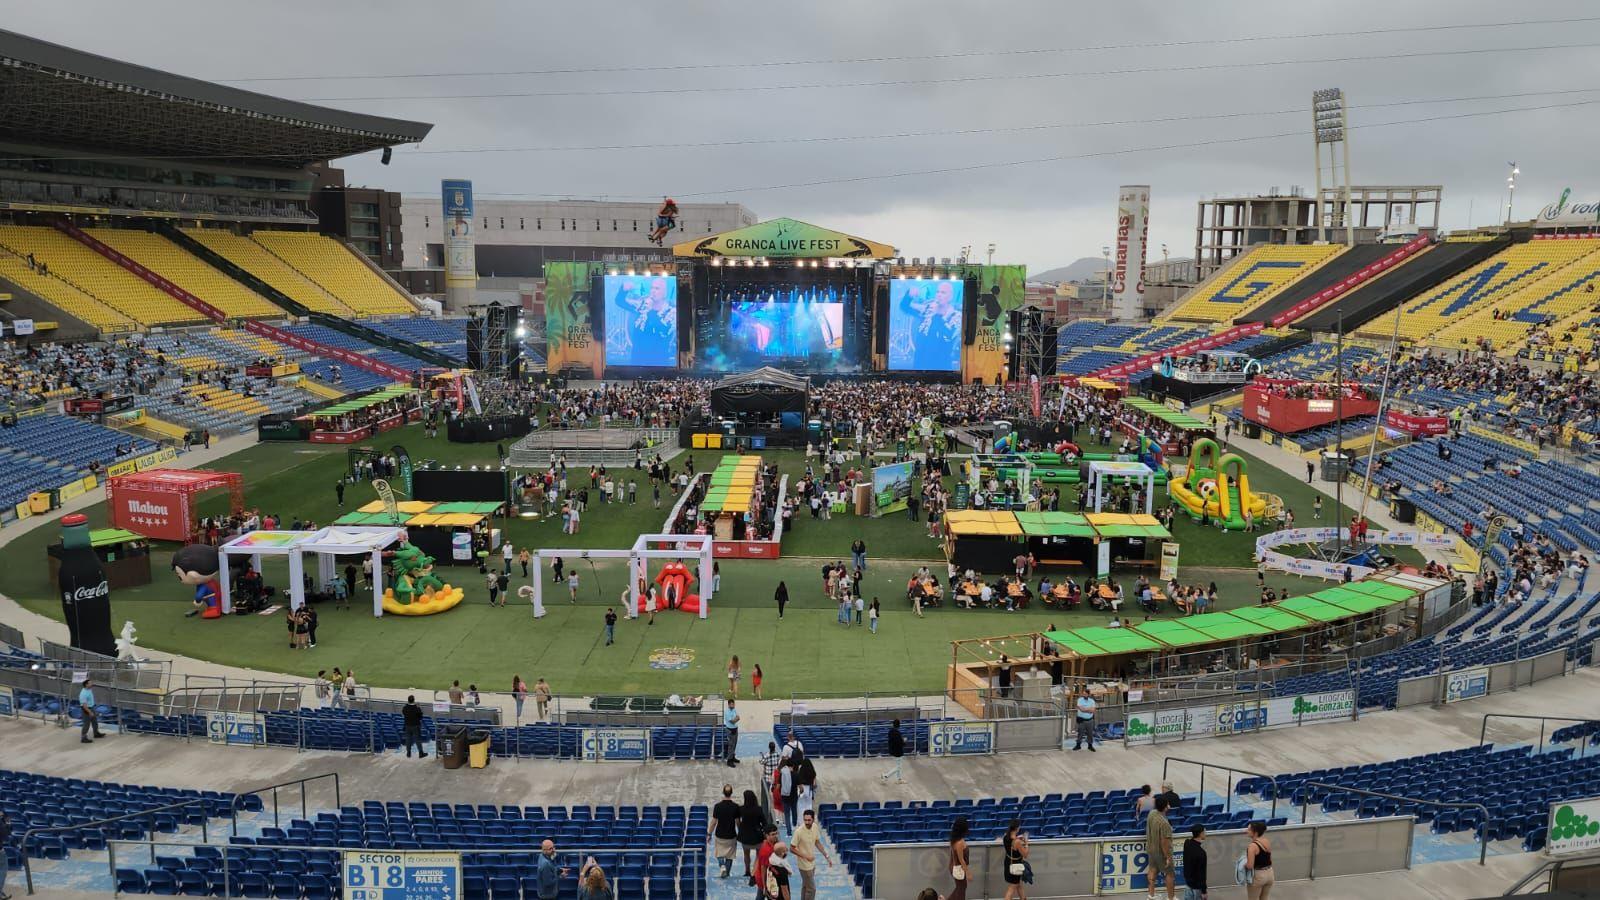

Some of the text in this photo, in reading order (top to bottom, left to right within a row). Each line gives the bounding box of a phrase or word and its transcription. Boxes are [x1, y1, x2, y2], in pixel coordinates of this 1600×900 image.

[726, 238, 841, 250] GRANCA LIVE FEST
[568, 340, 591, 349] FEST
[127, 500, 169, 516] Mahou
[1450, 680, 1468, 692] C21
[1219, 711, 1244, 724] C20
[209, 721, 236, 734] C17
[585, 738, 617, 751] C18
[933, 732, 962, 746] C19
[1110, 842, 1147, 853] SECTO
[359, 854, 401, 864] SECTOR
[1102, 852, 1149, 875] B19
[348, 865, 402, 887] B18
[415, 876, 443, 884] PARES
